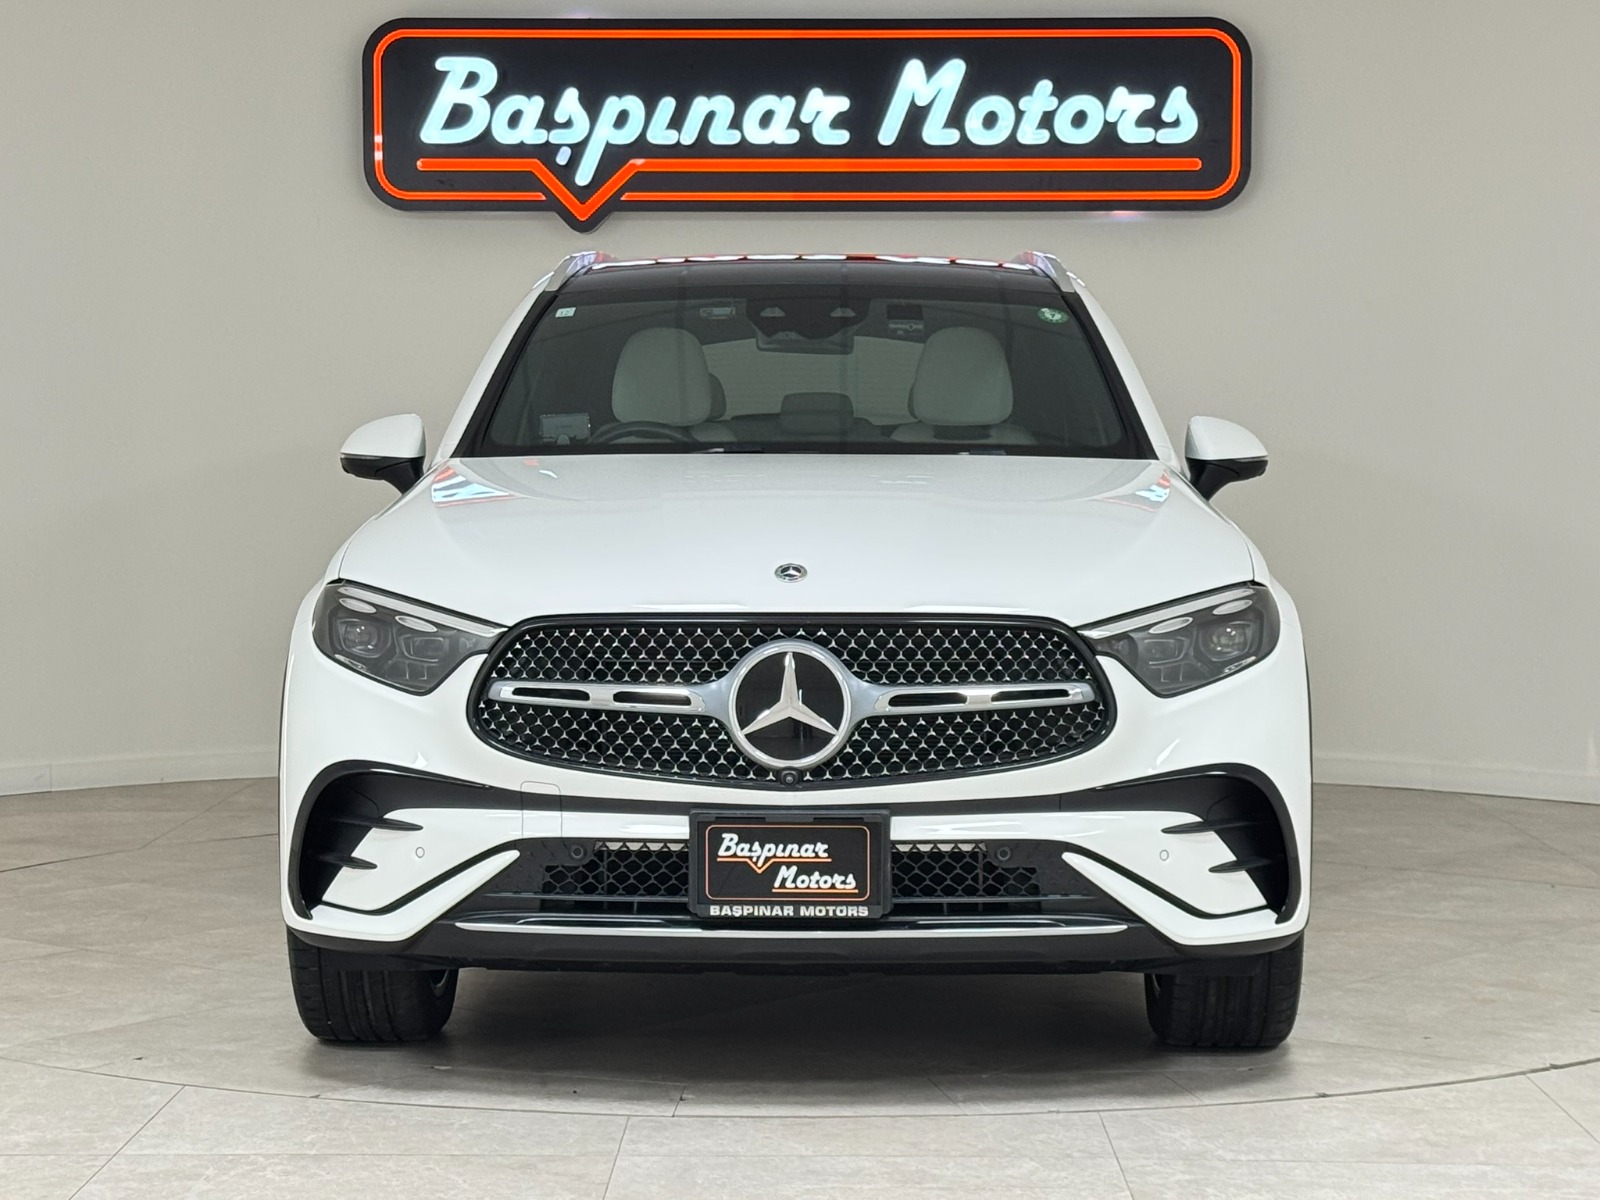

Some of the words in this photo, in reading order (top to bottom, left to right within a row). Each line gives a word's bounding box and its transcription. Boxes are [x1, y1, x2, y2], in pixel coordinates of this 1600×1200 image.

[877, 58, 1199, 146] Motors
[774, 865, 856, 889] Motors
[800, 905, 869, 917] MOTORS
